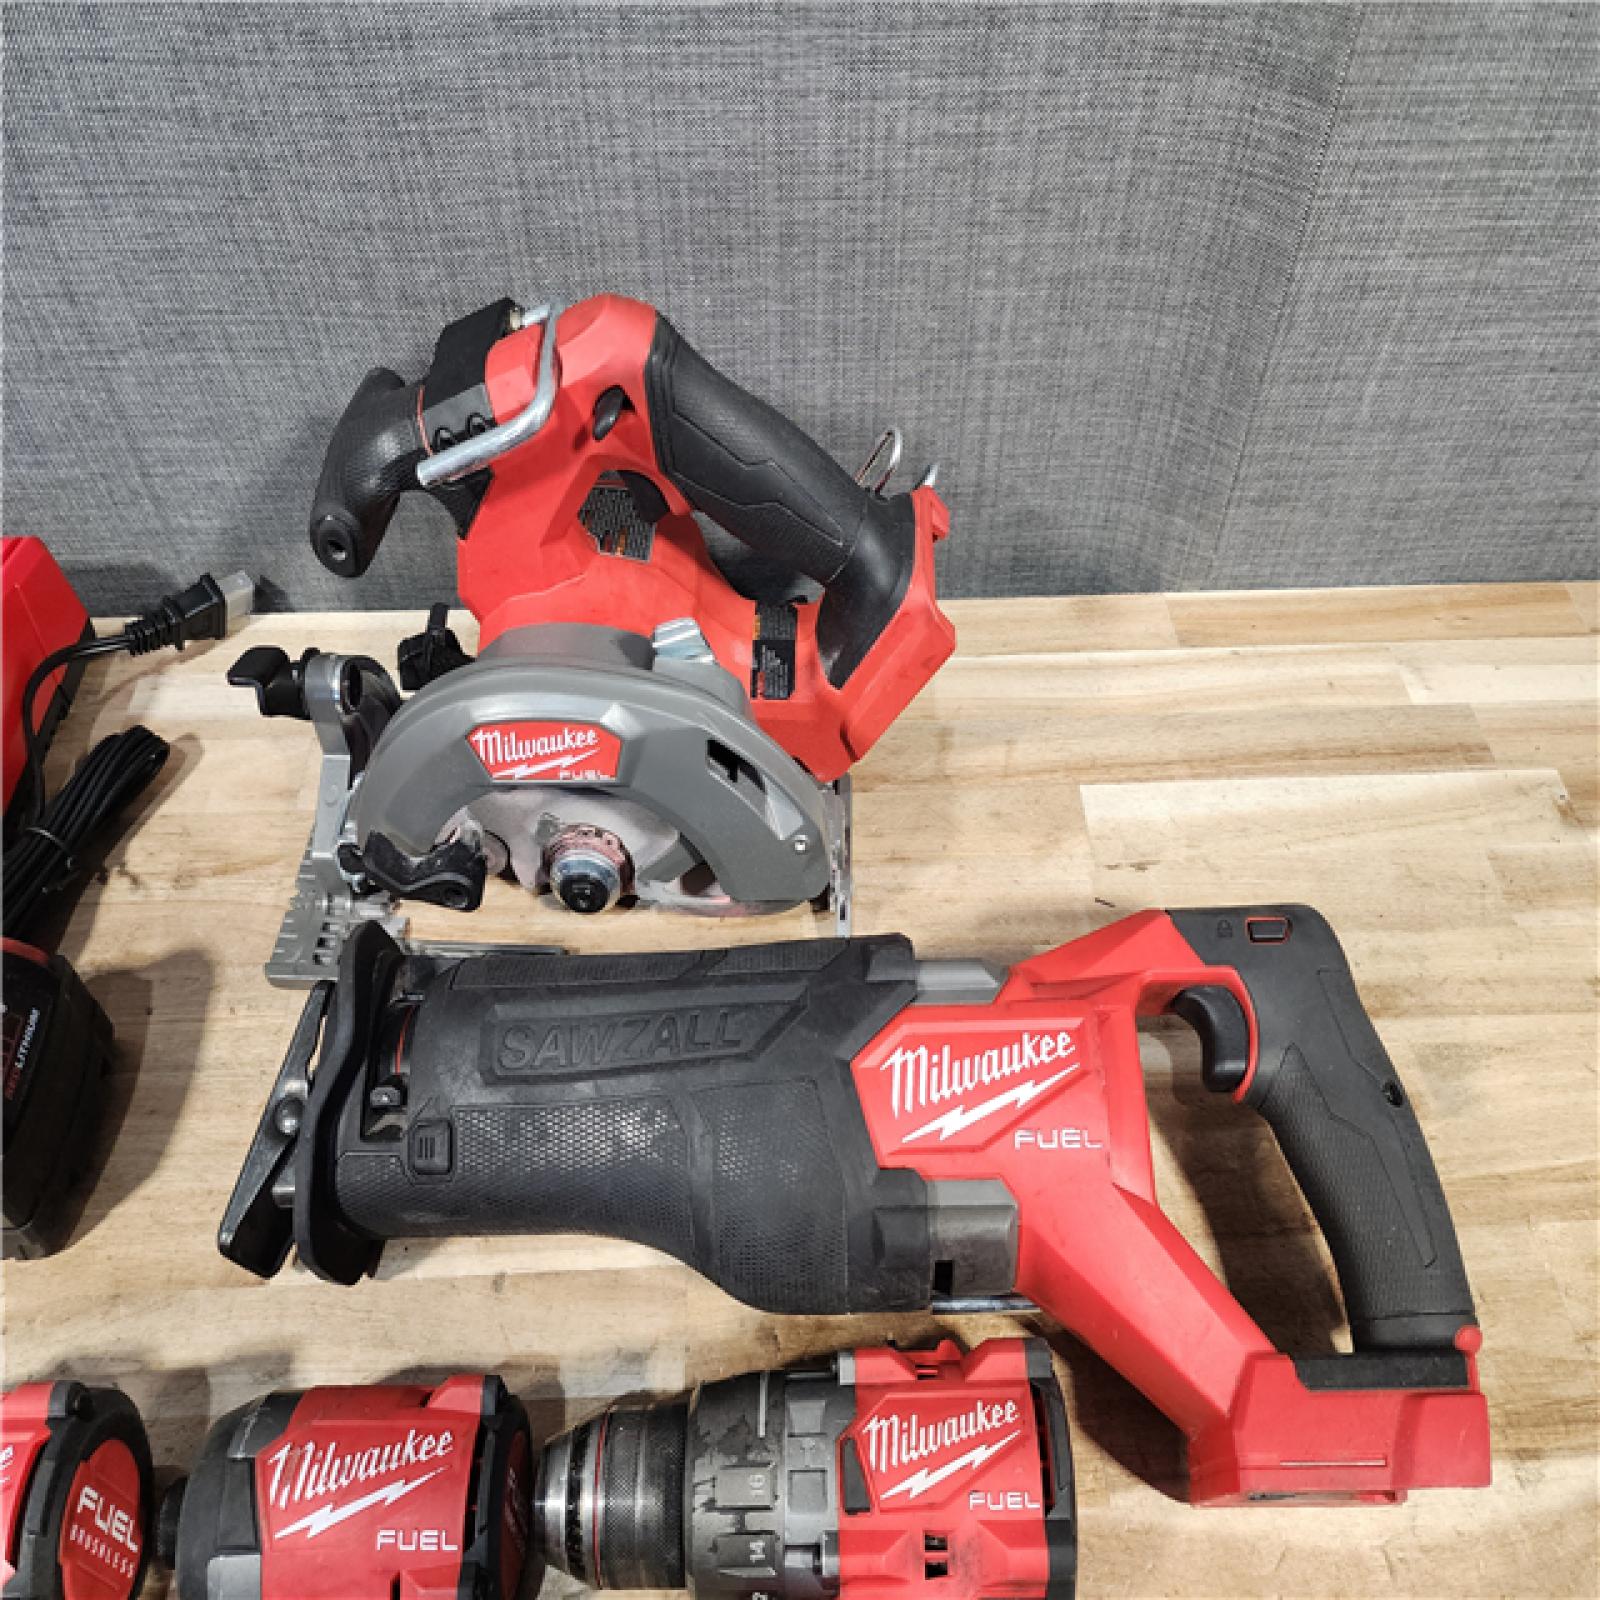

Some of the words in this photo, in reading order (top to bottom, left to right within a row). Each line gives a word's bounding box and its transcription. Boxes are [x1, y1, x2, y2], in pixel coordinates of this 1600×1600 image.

[472, 727, 599, 765] Milwaukee
[499, 1008, 742, 1071] SAWZALL
[879, 1031, 1077, 1119] Milwaukee
[1013, 1129, 1103, 1149] FUEL
[860, 1399, 1021, 1473] Milwaukee
[267, 1428, 455, 1510] Milwaukee
[77, 1484, 139, 1553] FUEL
[968, 1491, 1041, 1511] FUEL
[376, 1529, 458, 1551] FUEL
